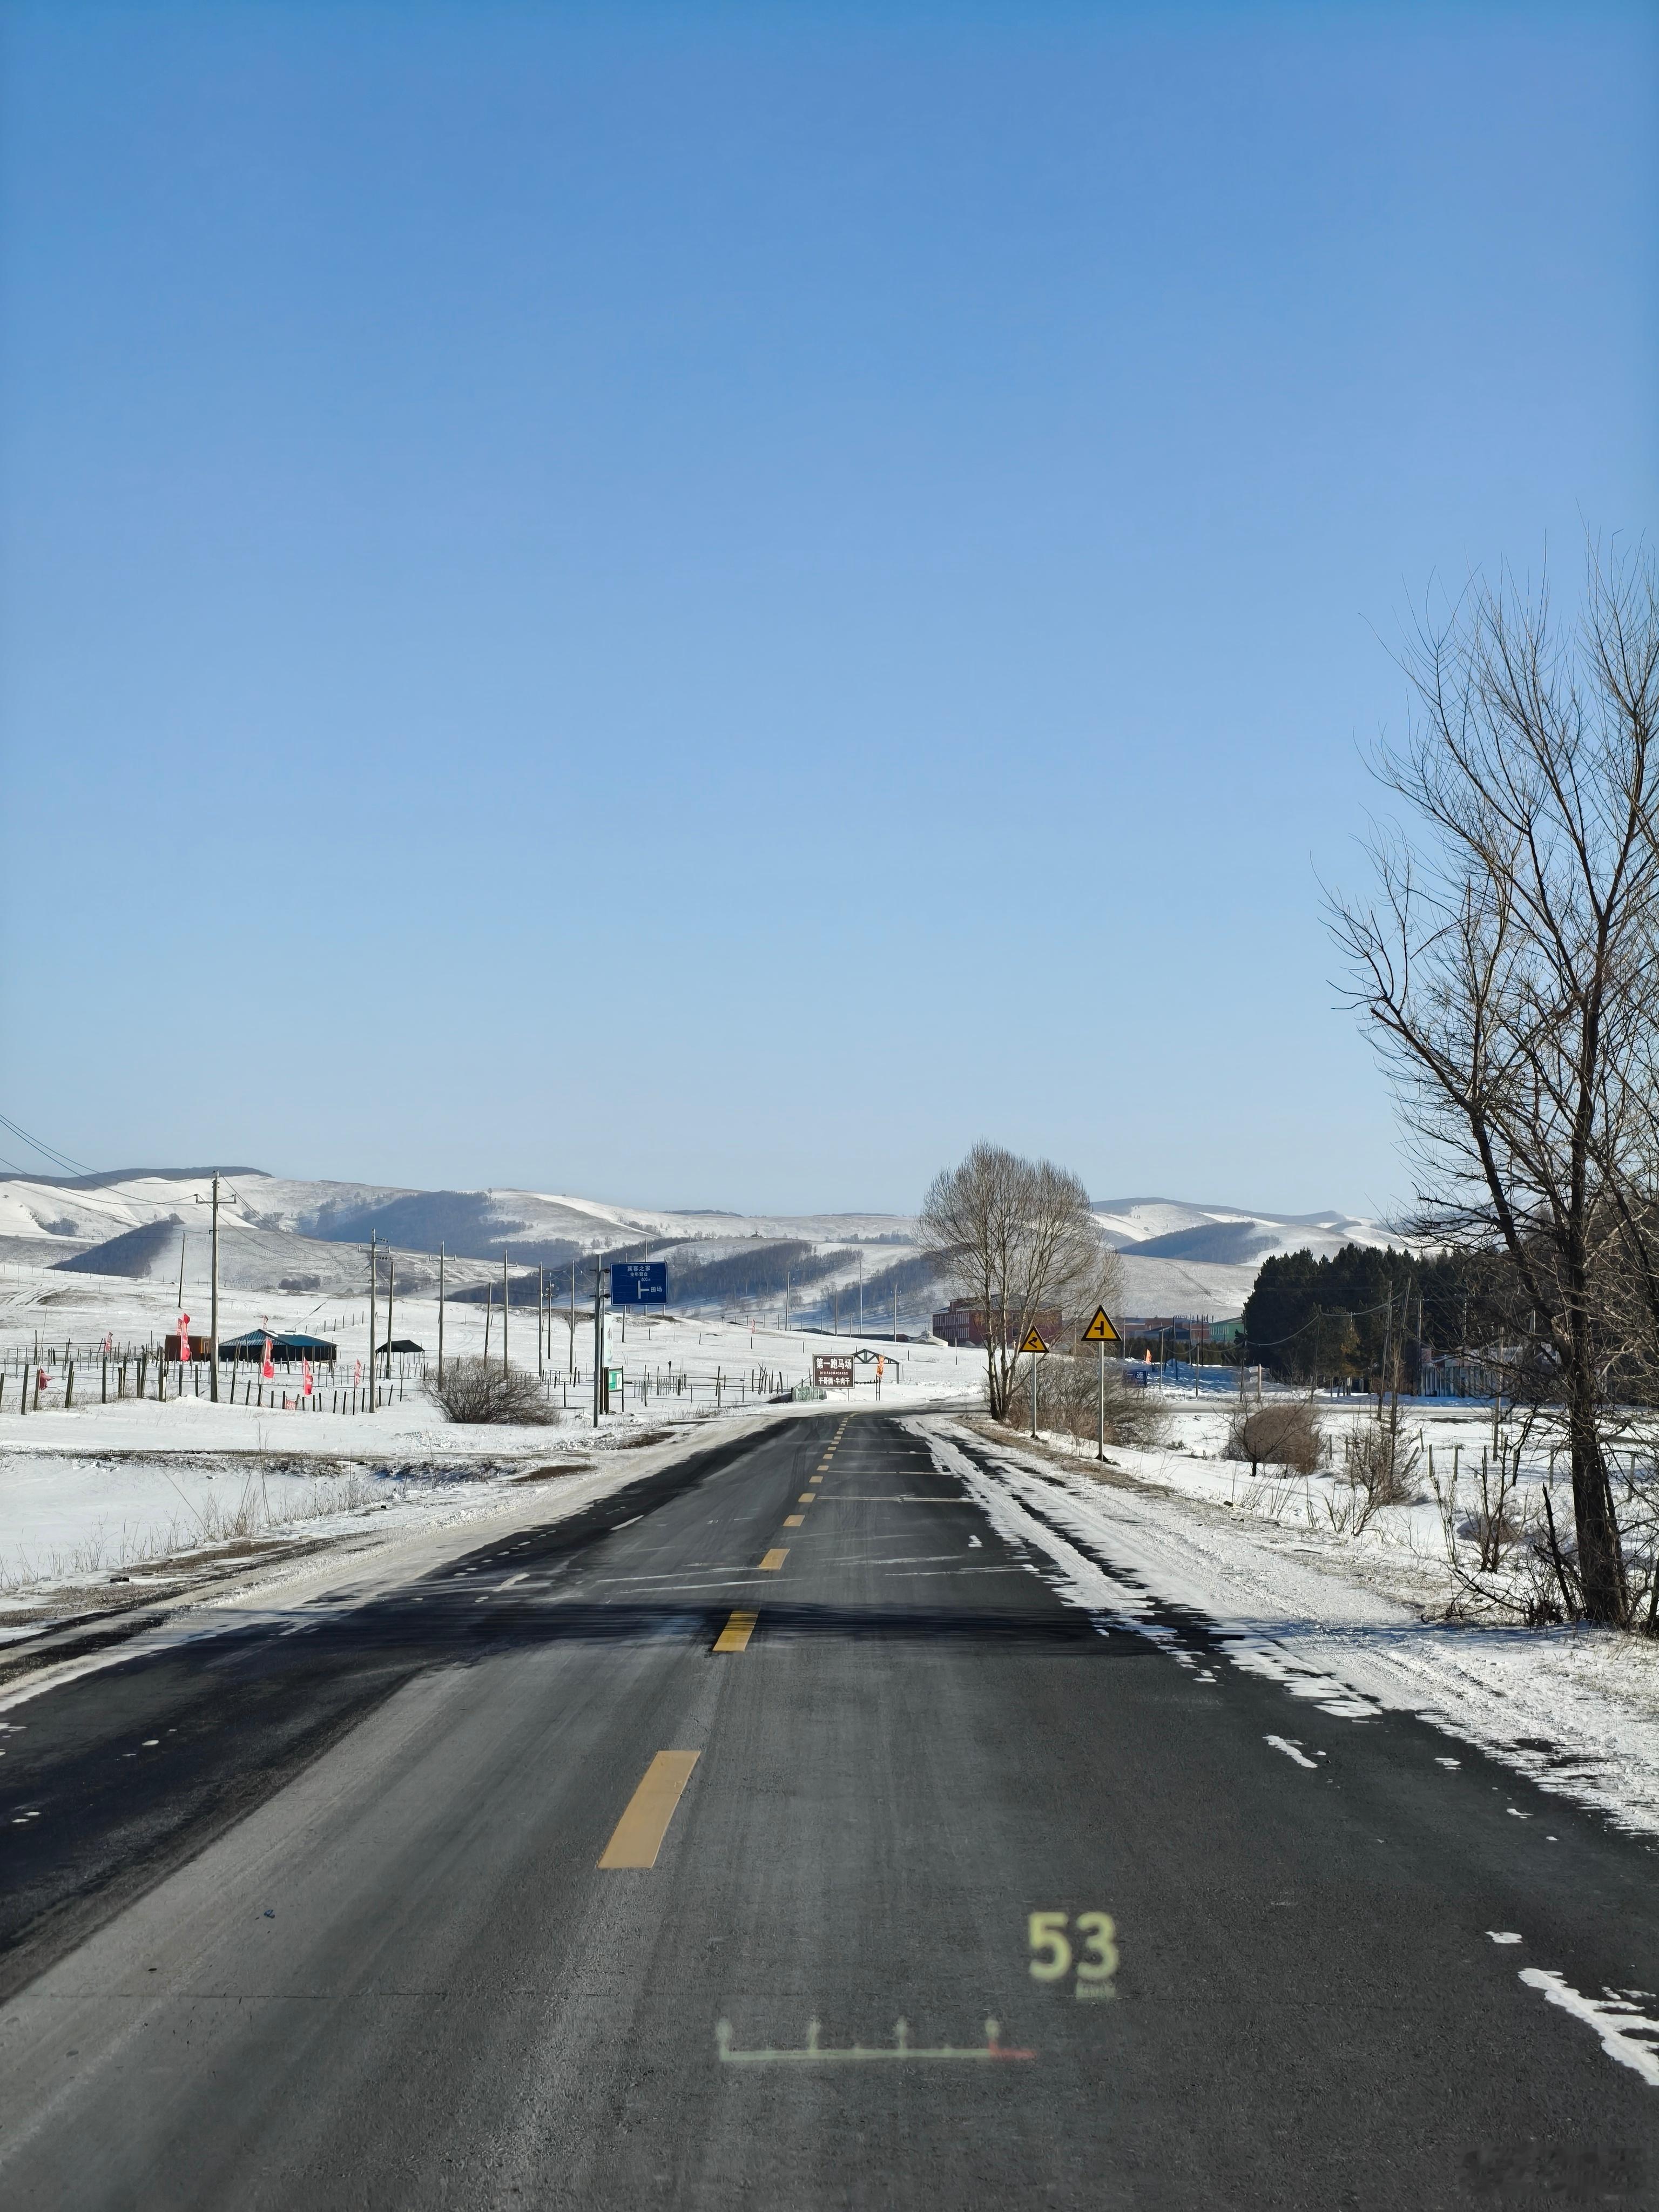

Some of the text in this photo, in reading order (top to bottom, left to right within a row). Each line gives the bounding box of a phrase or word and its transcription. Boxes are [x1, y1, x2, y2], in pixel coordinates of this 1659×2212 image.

[816, 1358, 852, 1370] 第一跑马场
[1028, 1911, 1119, 1981] 53
